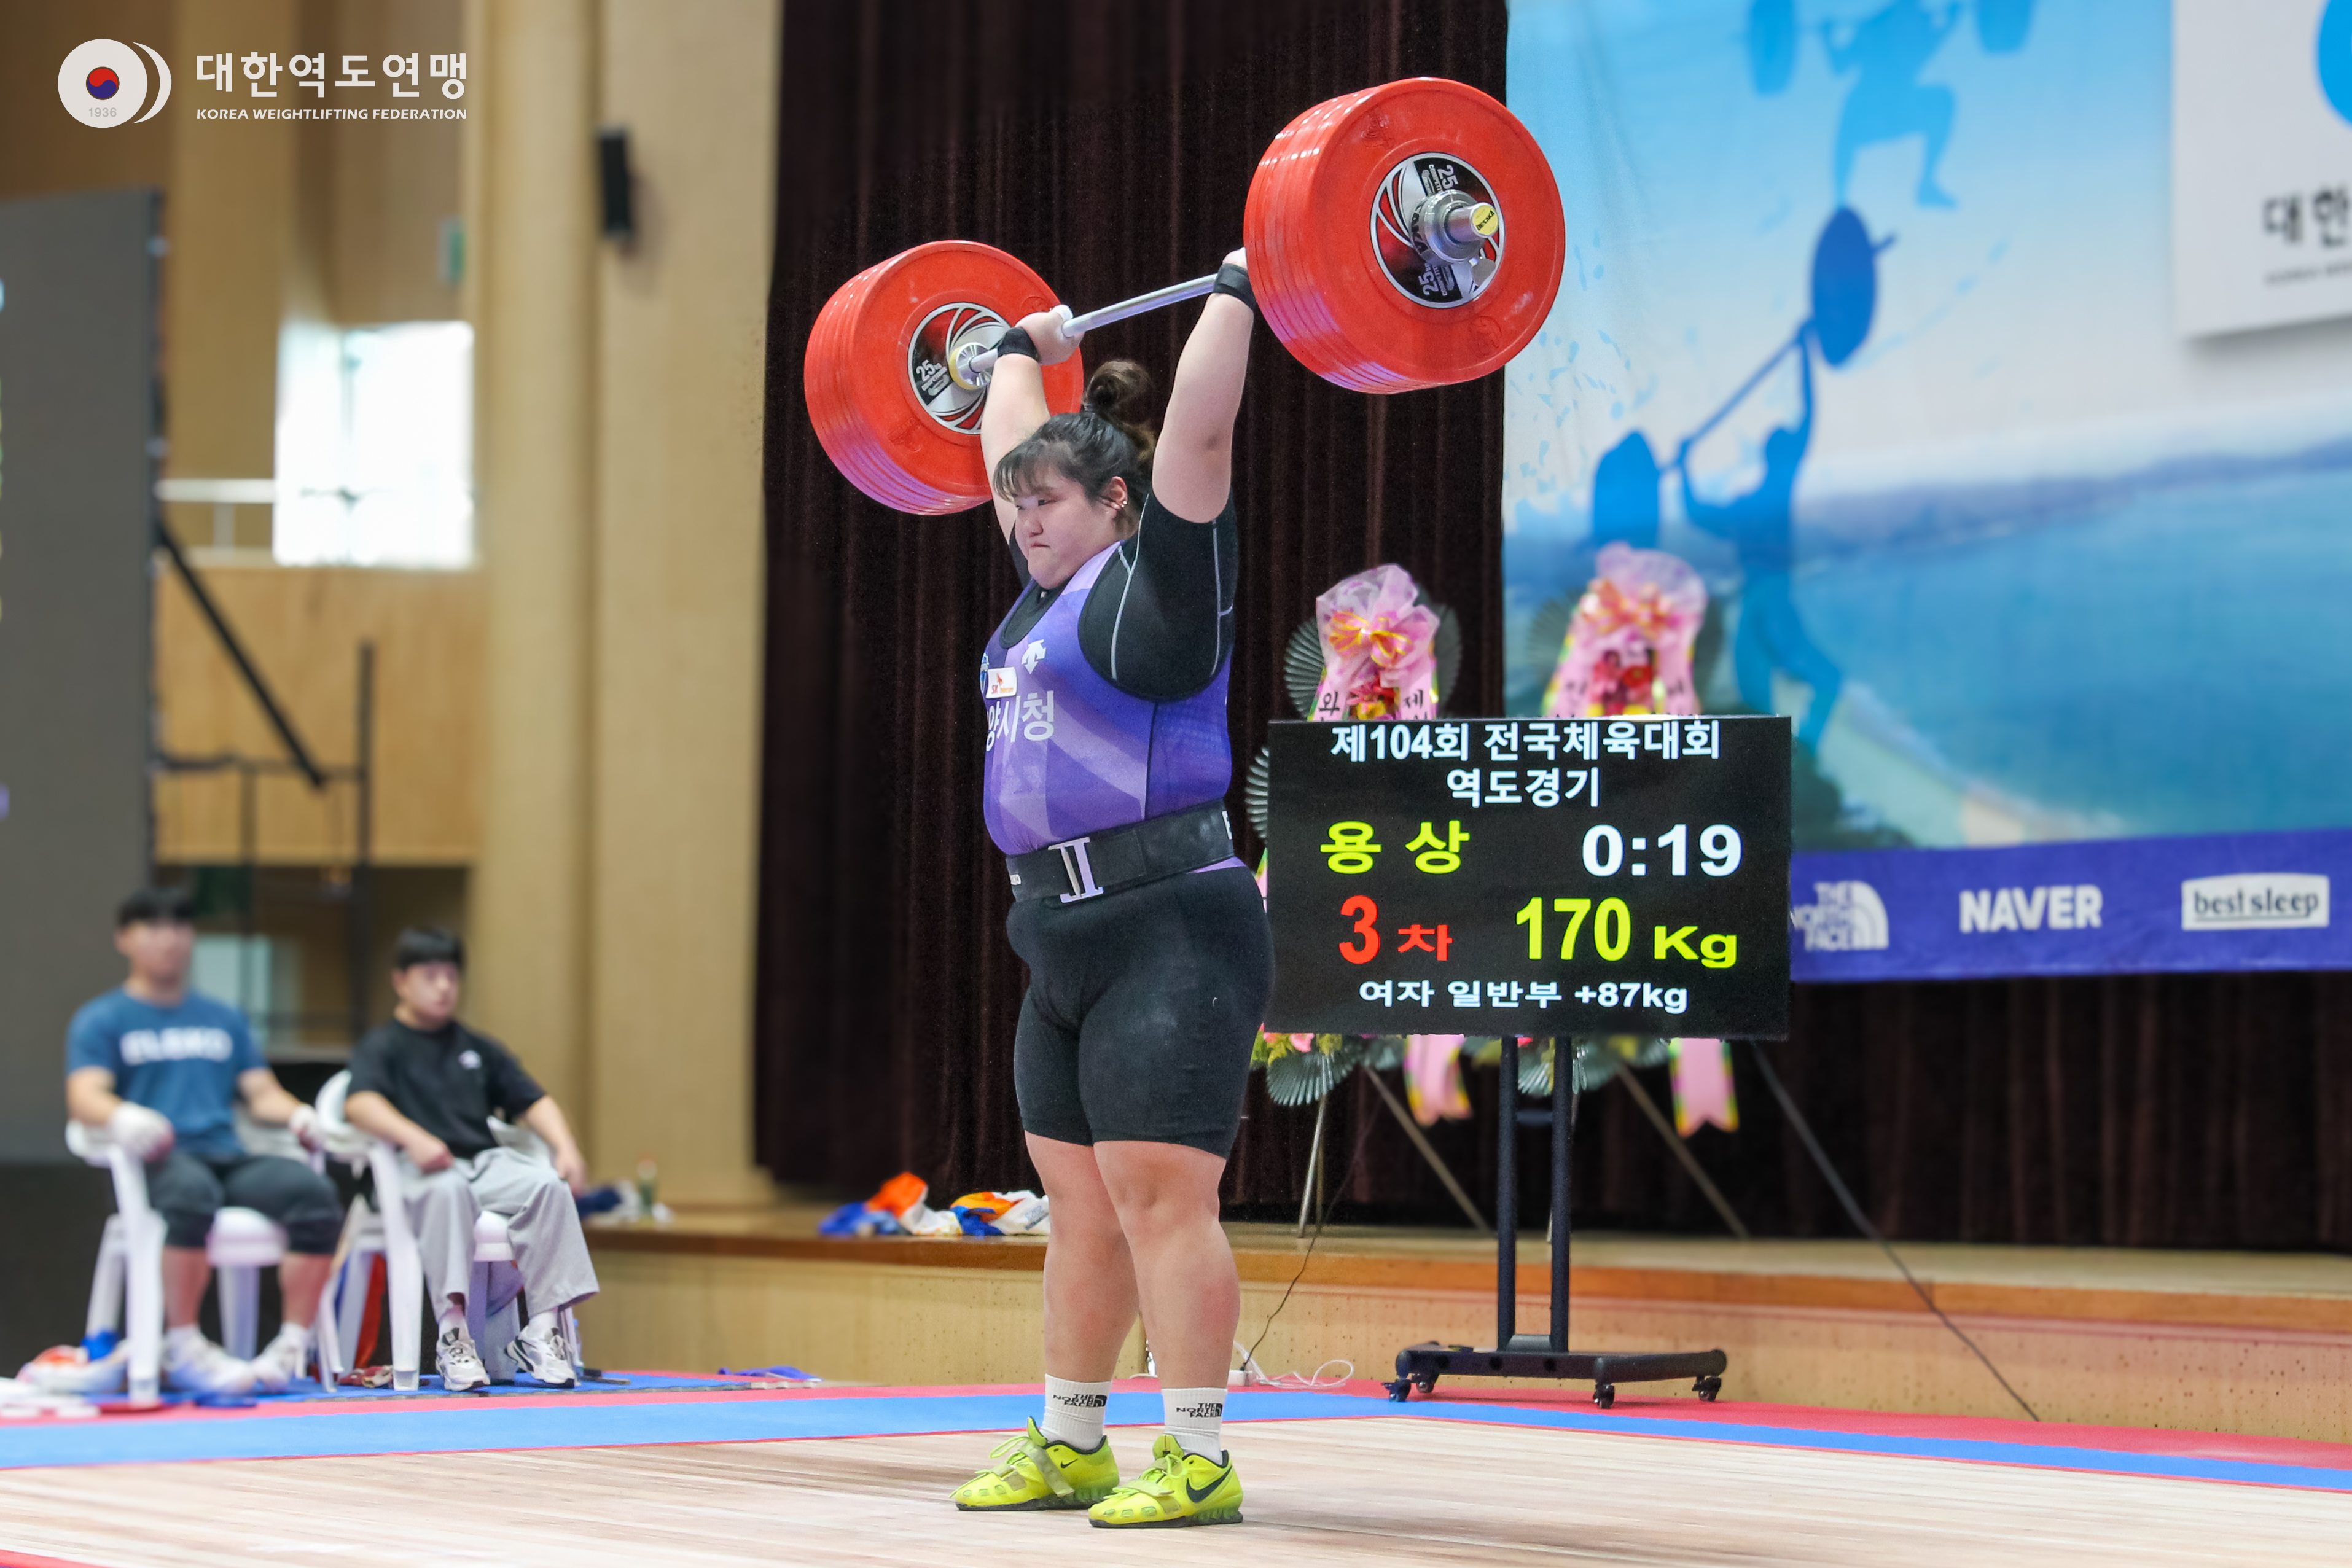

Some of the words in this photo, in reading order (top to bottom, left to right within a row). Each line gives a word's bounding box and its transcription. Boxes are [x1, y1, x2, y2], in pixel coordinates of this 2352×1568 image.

[1428, 164, 1443, 193] COMPETIT
[985, 690, 1055, 752] 양시청
[1330, 723, 1470, 762] 제104회
[1483, 719, 1720, 762] 전국체육대회
[1446, 766, 1600, 808] 역도경기
[1320, 821, 1382, 875] 용
[1405, 819, 1471, 874] 상
[1582, 824, 1743, 877] 0:19
[1959, 884, 2104, 934] NAVER
[2194, 889, 2244, 915] best
[2250, 888, 2319, 918] sleep
[1338, 895, 1381, 964] 3
[1397, 923, 1454, 961] 차
[1516, 897, 1631, 961] 170
[1654, 926, 1738, 969] Kg
[1359, 980, 1436, 1008] 여자
[1447, 980, 1563, 1009] 일반부
[1574, 981, 1688, 1015] +87kg
[1053, 1394, 1094, 1405] NORTH
